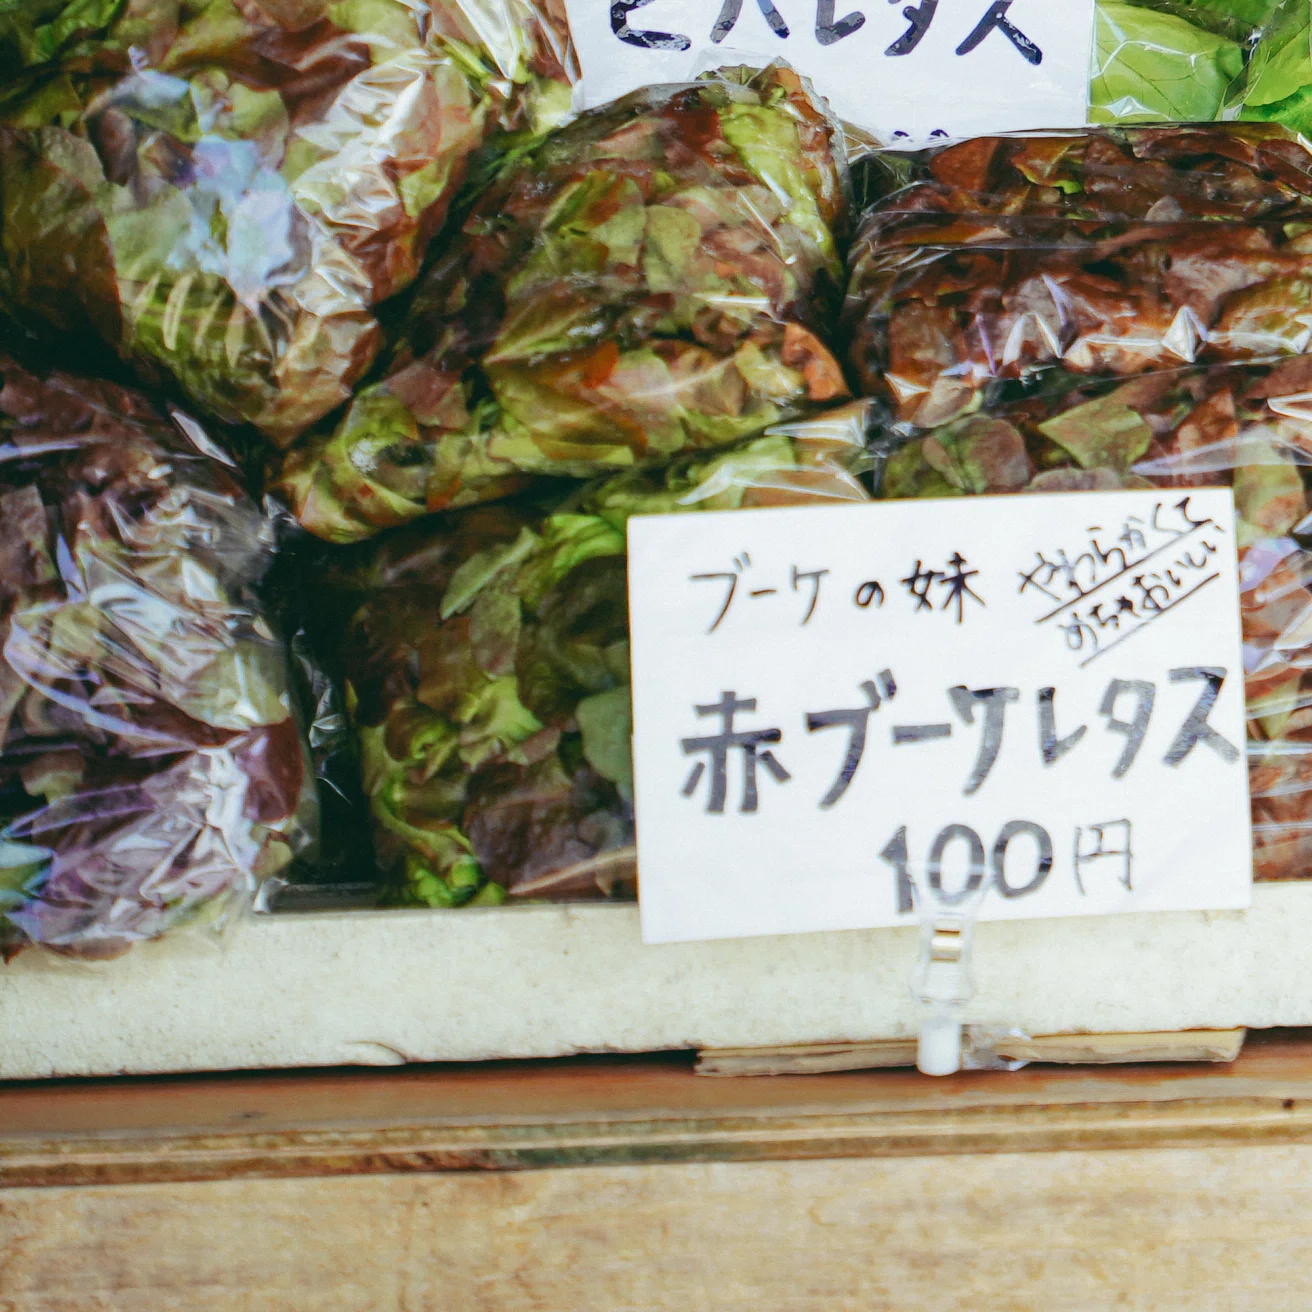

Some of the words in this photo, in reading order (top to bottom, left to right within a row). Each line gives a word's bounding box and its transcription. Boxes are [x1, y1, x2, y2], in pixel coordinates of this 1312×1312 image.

[690, 551, 986, 634] ブーケの妹
[1018, 496, 1214, 598] やわらかくて
[680, 665, 1242, 815] 赤ブーケレタス
[879, 818, 1134, 914] 100円
